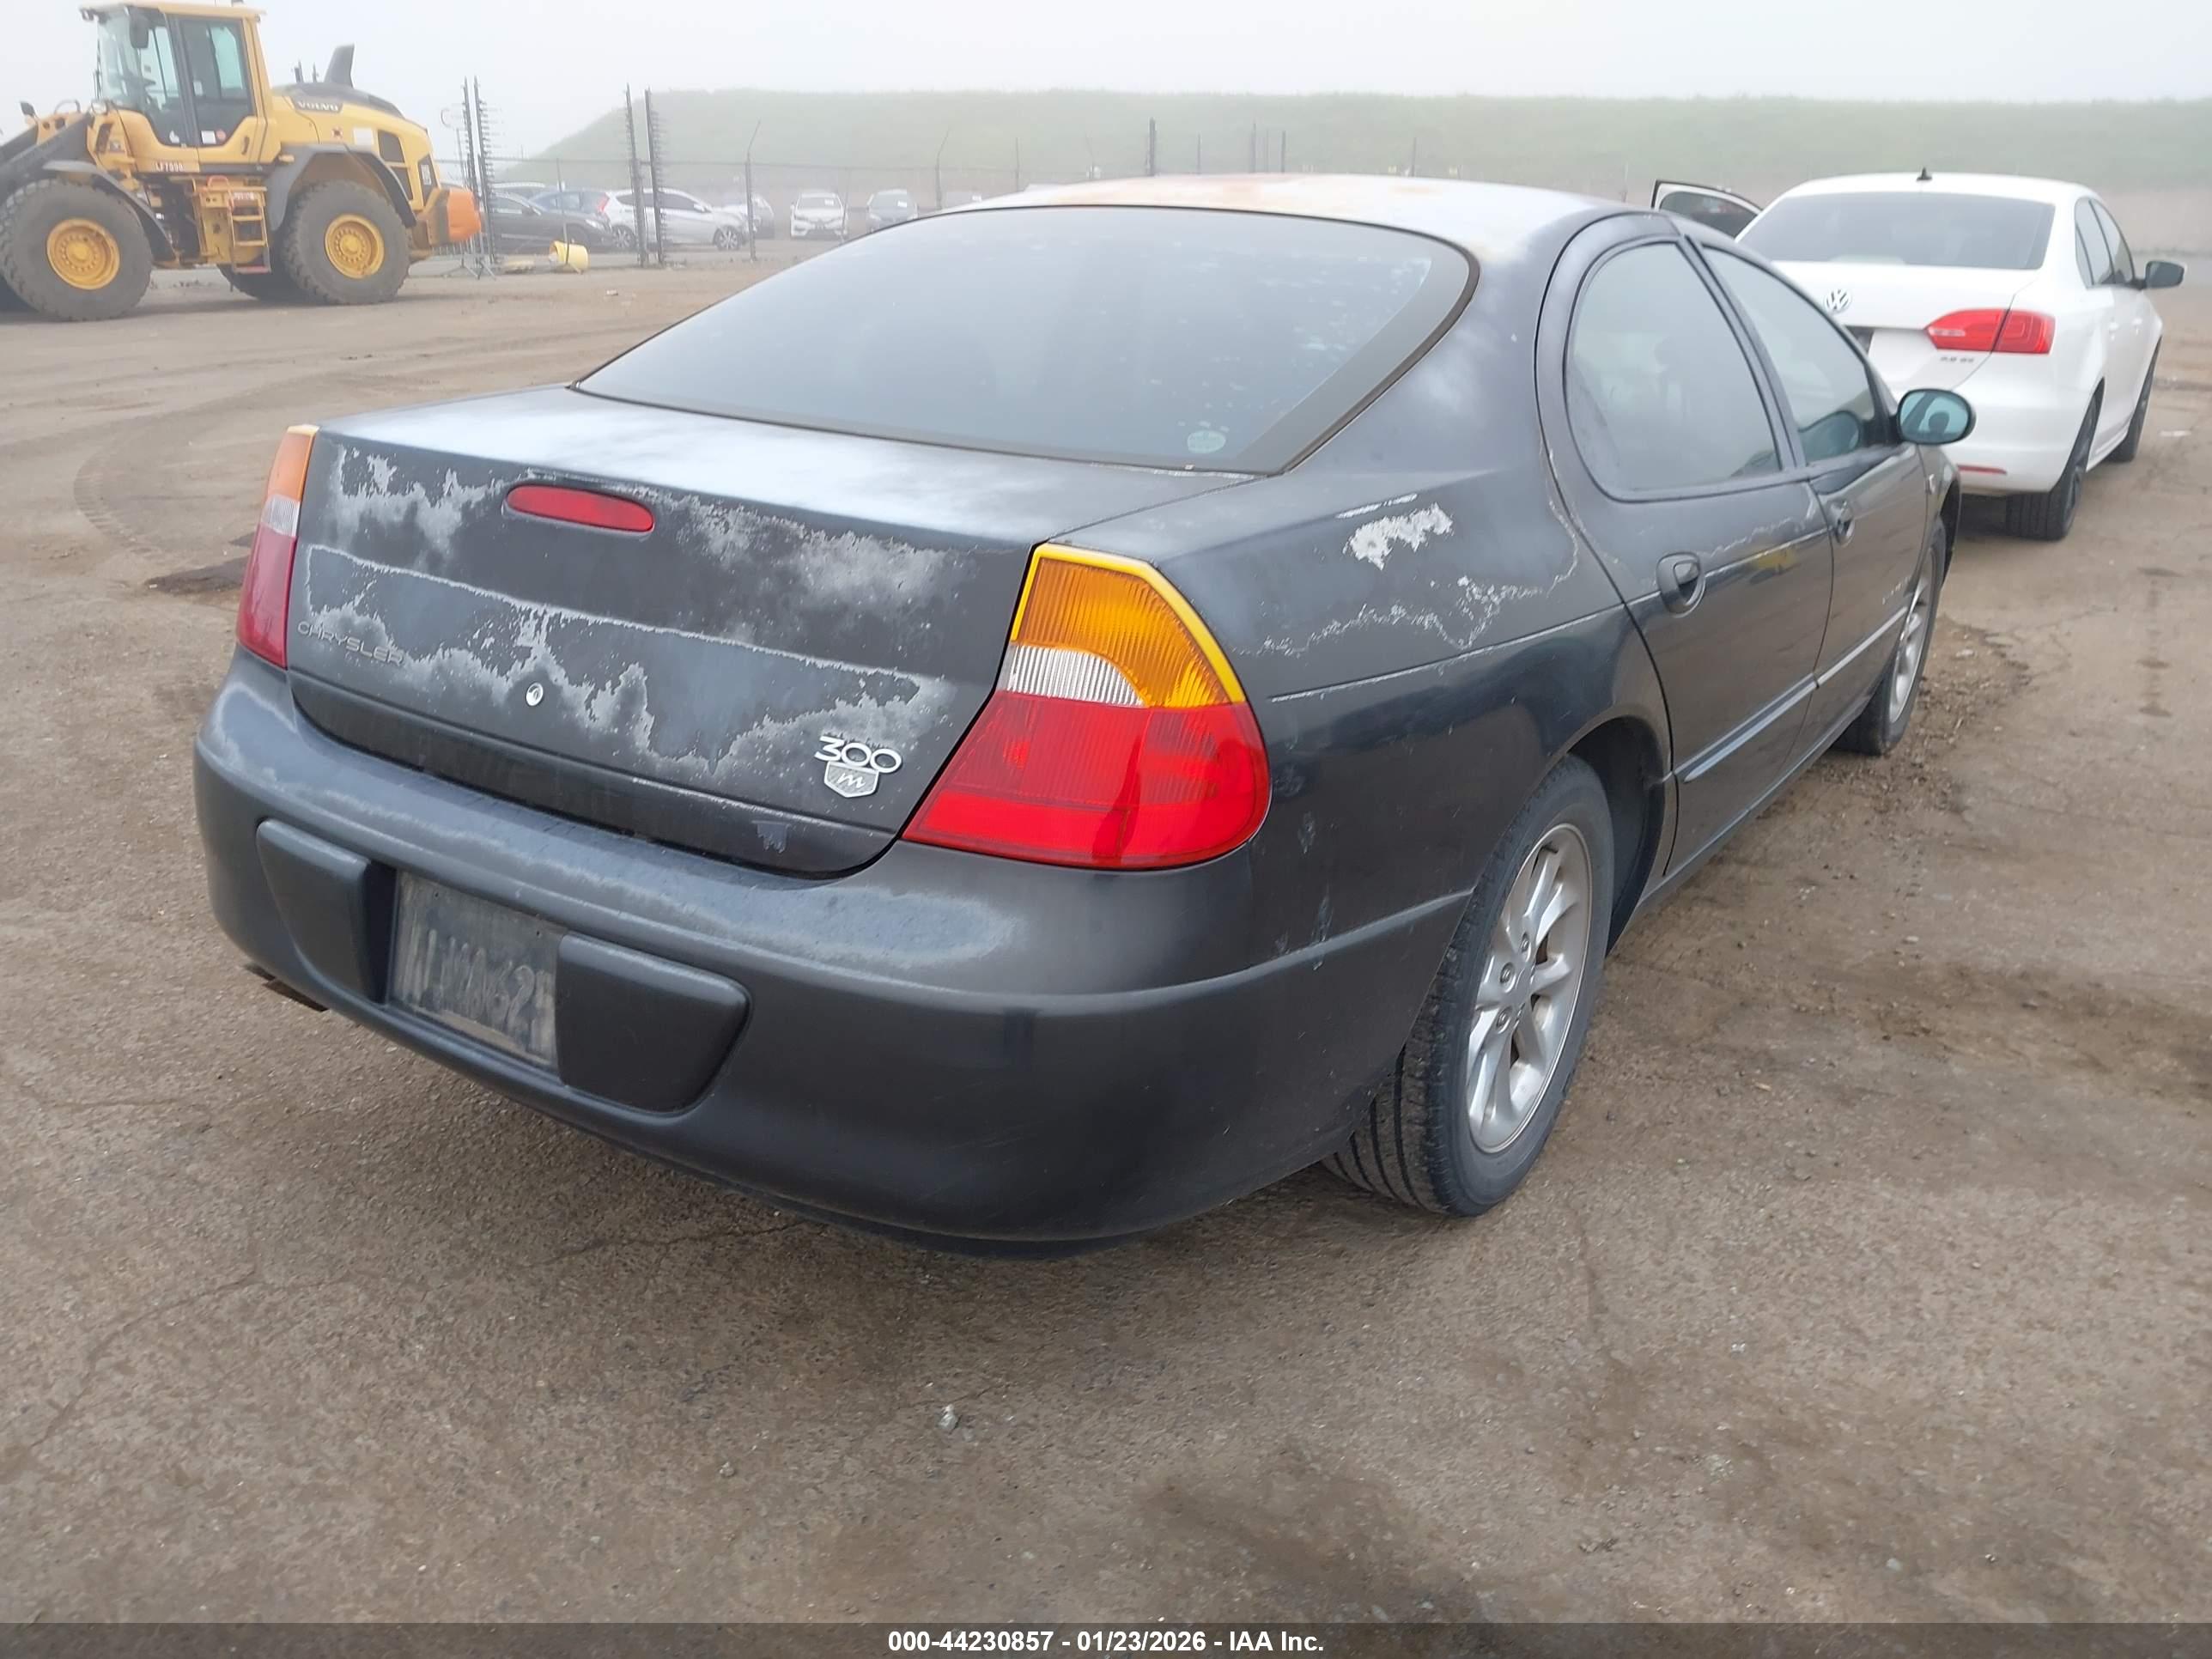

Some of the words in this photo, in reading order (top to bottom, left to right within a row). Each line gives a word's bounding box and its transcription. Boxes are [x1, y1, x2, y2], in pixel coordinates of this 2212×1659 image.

[297, 101, 338, 111] VOLVO
[297, 621, 404, 666] CHRYSLER
[814, 736, 902, 773] 300
